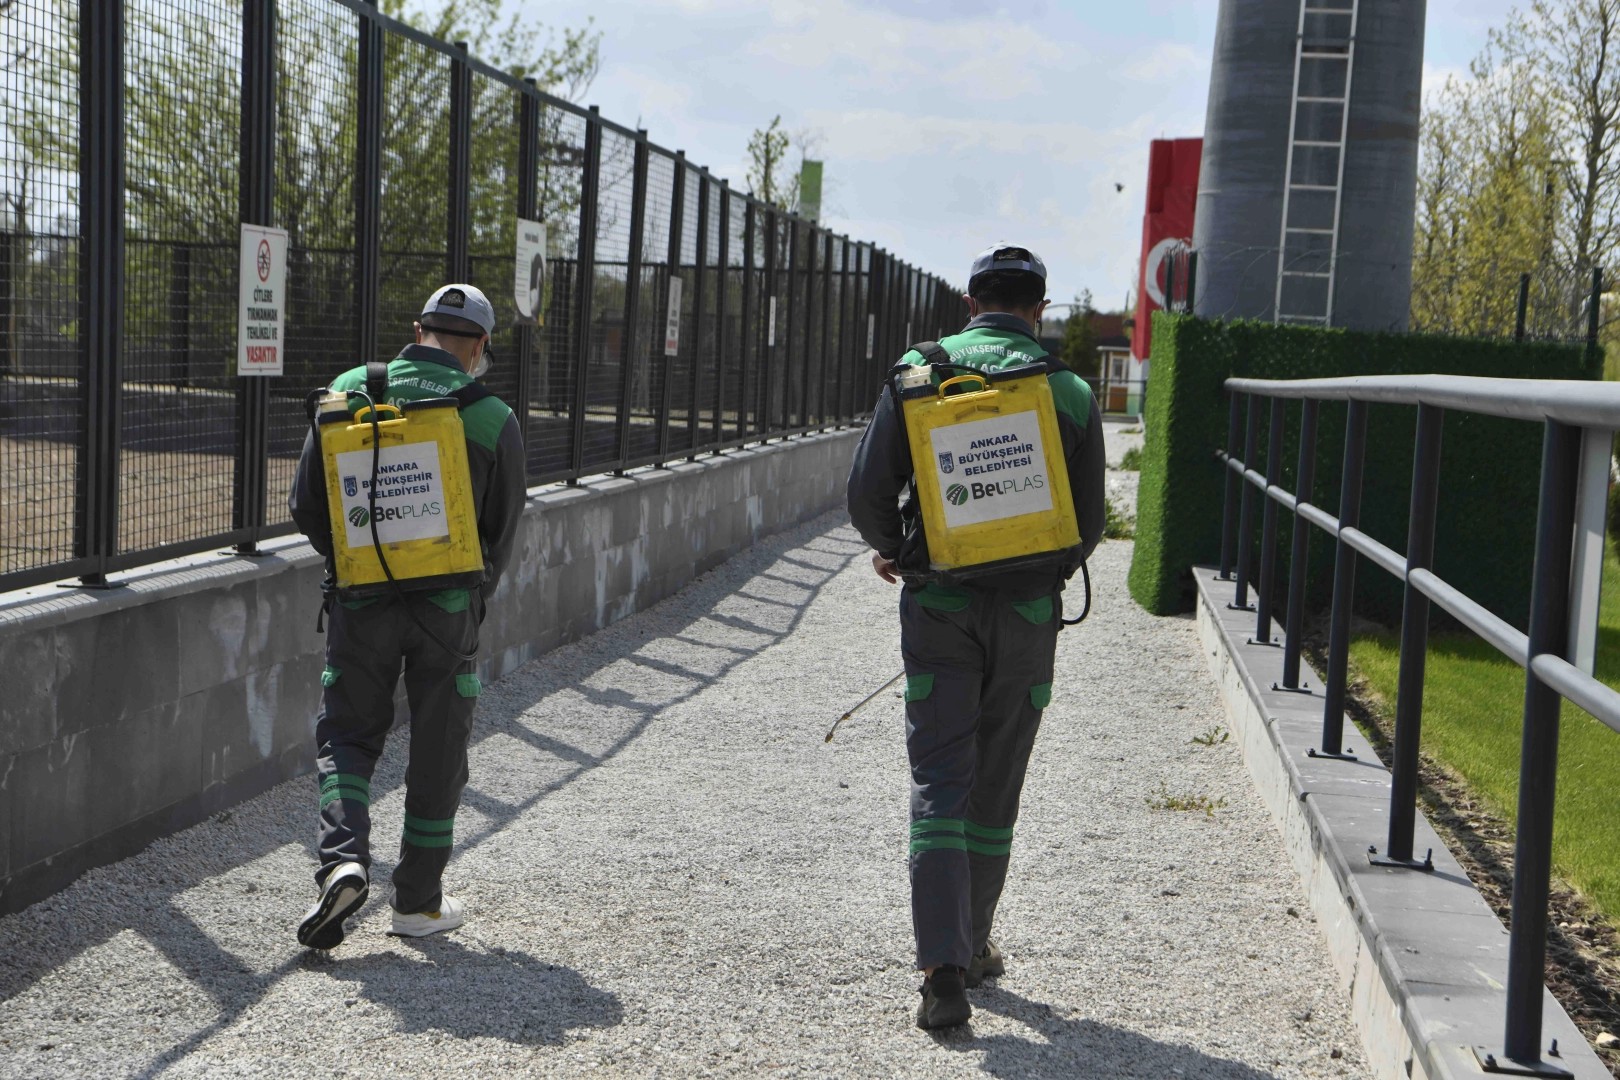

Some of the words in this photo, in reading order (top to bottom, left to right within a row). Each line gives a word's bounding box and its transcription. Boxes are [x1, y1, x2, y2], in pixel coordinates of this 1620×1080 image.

[253, 285, 273, 304] ÇİTLERE
[247, 307, 278, 322] TIRMANMAK
[246, 323, 271, 340] TEHLİKELİ
[272, 327, 278, 341] VE
[246, 345, 277, 363] YASAKTIR
[970, 433, 1018, 450] ANKARA
[958, 443, 1034, 465] BÜYÜKŞEHİR
[964, 455, 1032, 477] BELEDİYESİ
[970, 474, 1044, 500] BelPLAS
[374, 501, 441, 523] BelPLAS
